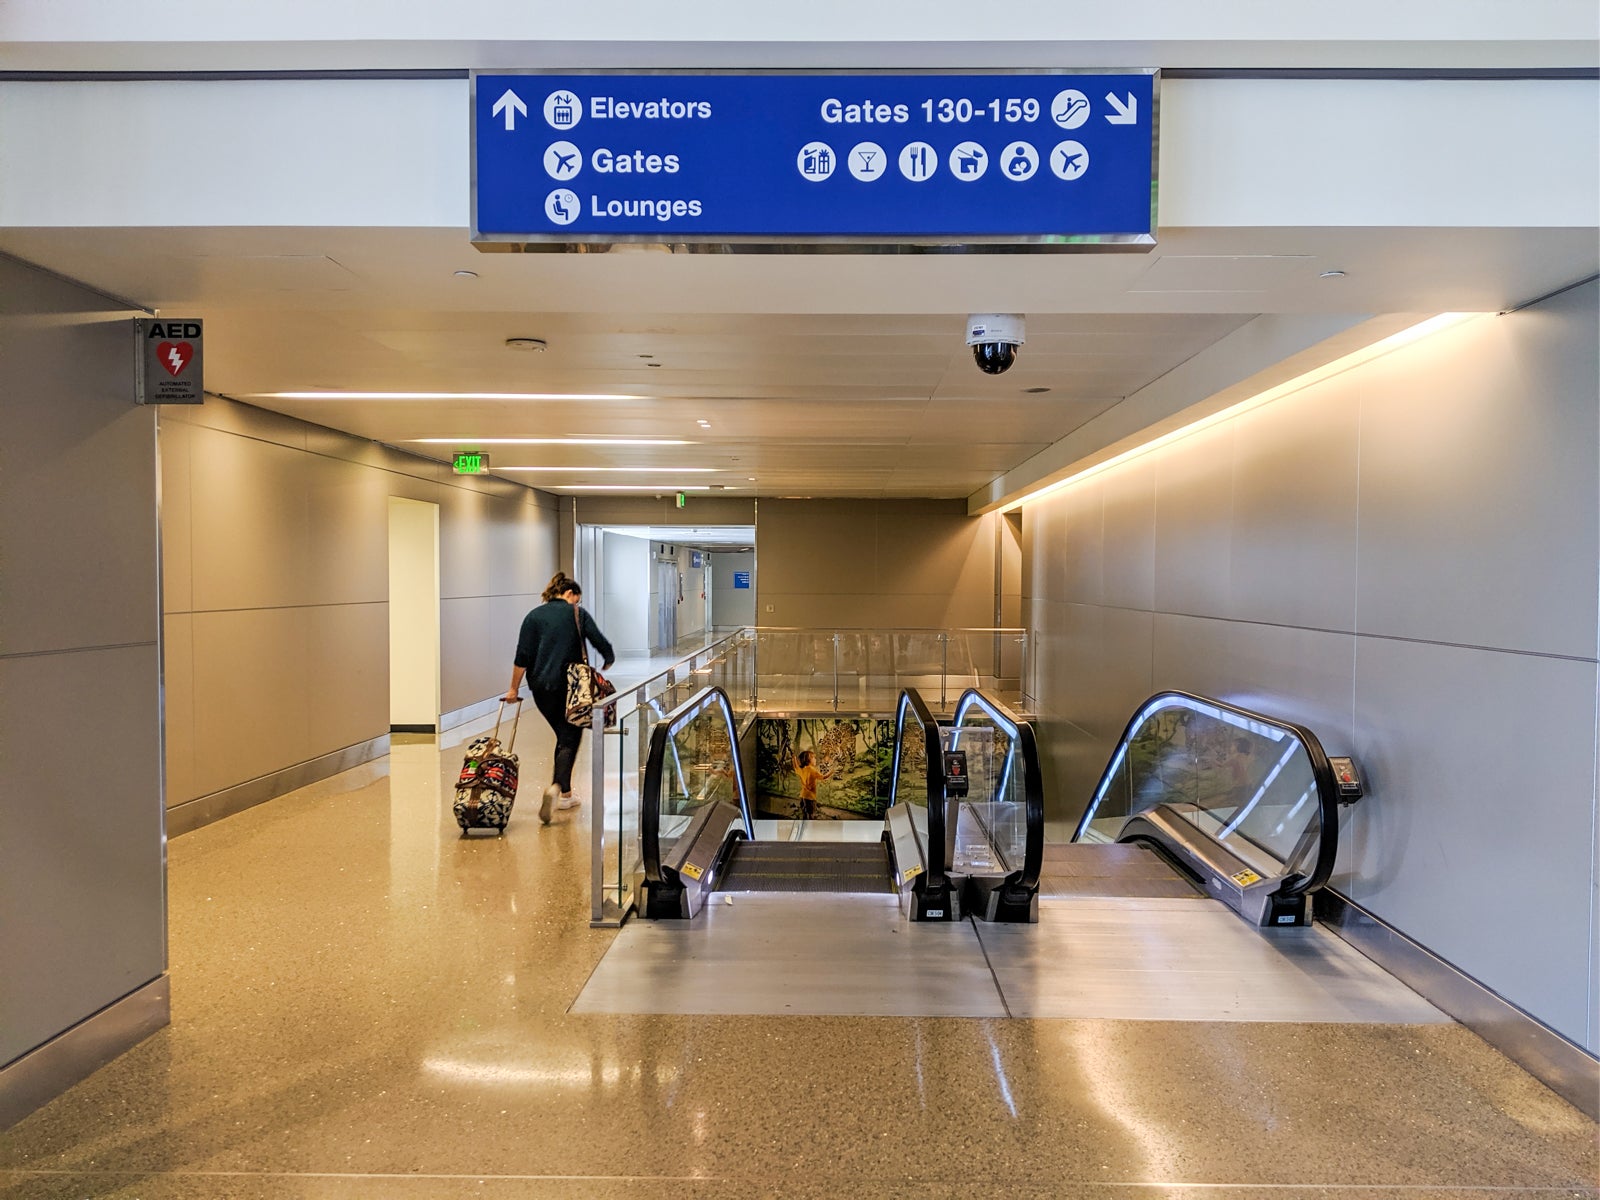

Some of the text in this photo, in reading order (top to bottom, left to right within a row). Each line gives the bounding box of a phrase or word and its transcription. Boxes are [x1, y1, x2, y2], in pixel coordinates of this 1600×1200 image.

[590, 96, 712, 120] Elevators
[820, 97, 1041, 123] Gates 130-159
[591, 148, 680, 174] Gates
[591, 194, 703, 222] Lounges
[148, 323, 201, 338] AED
[458, 455, 482, 473] EXIT
